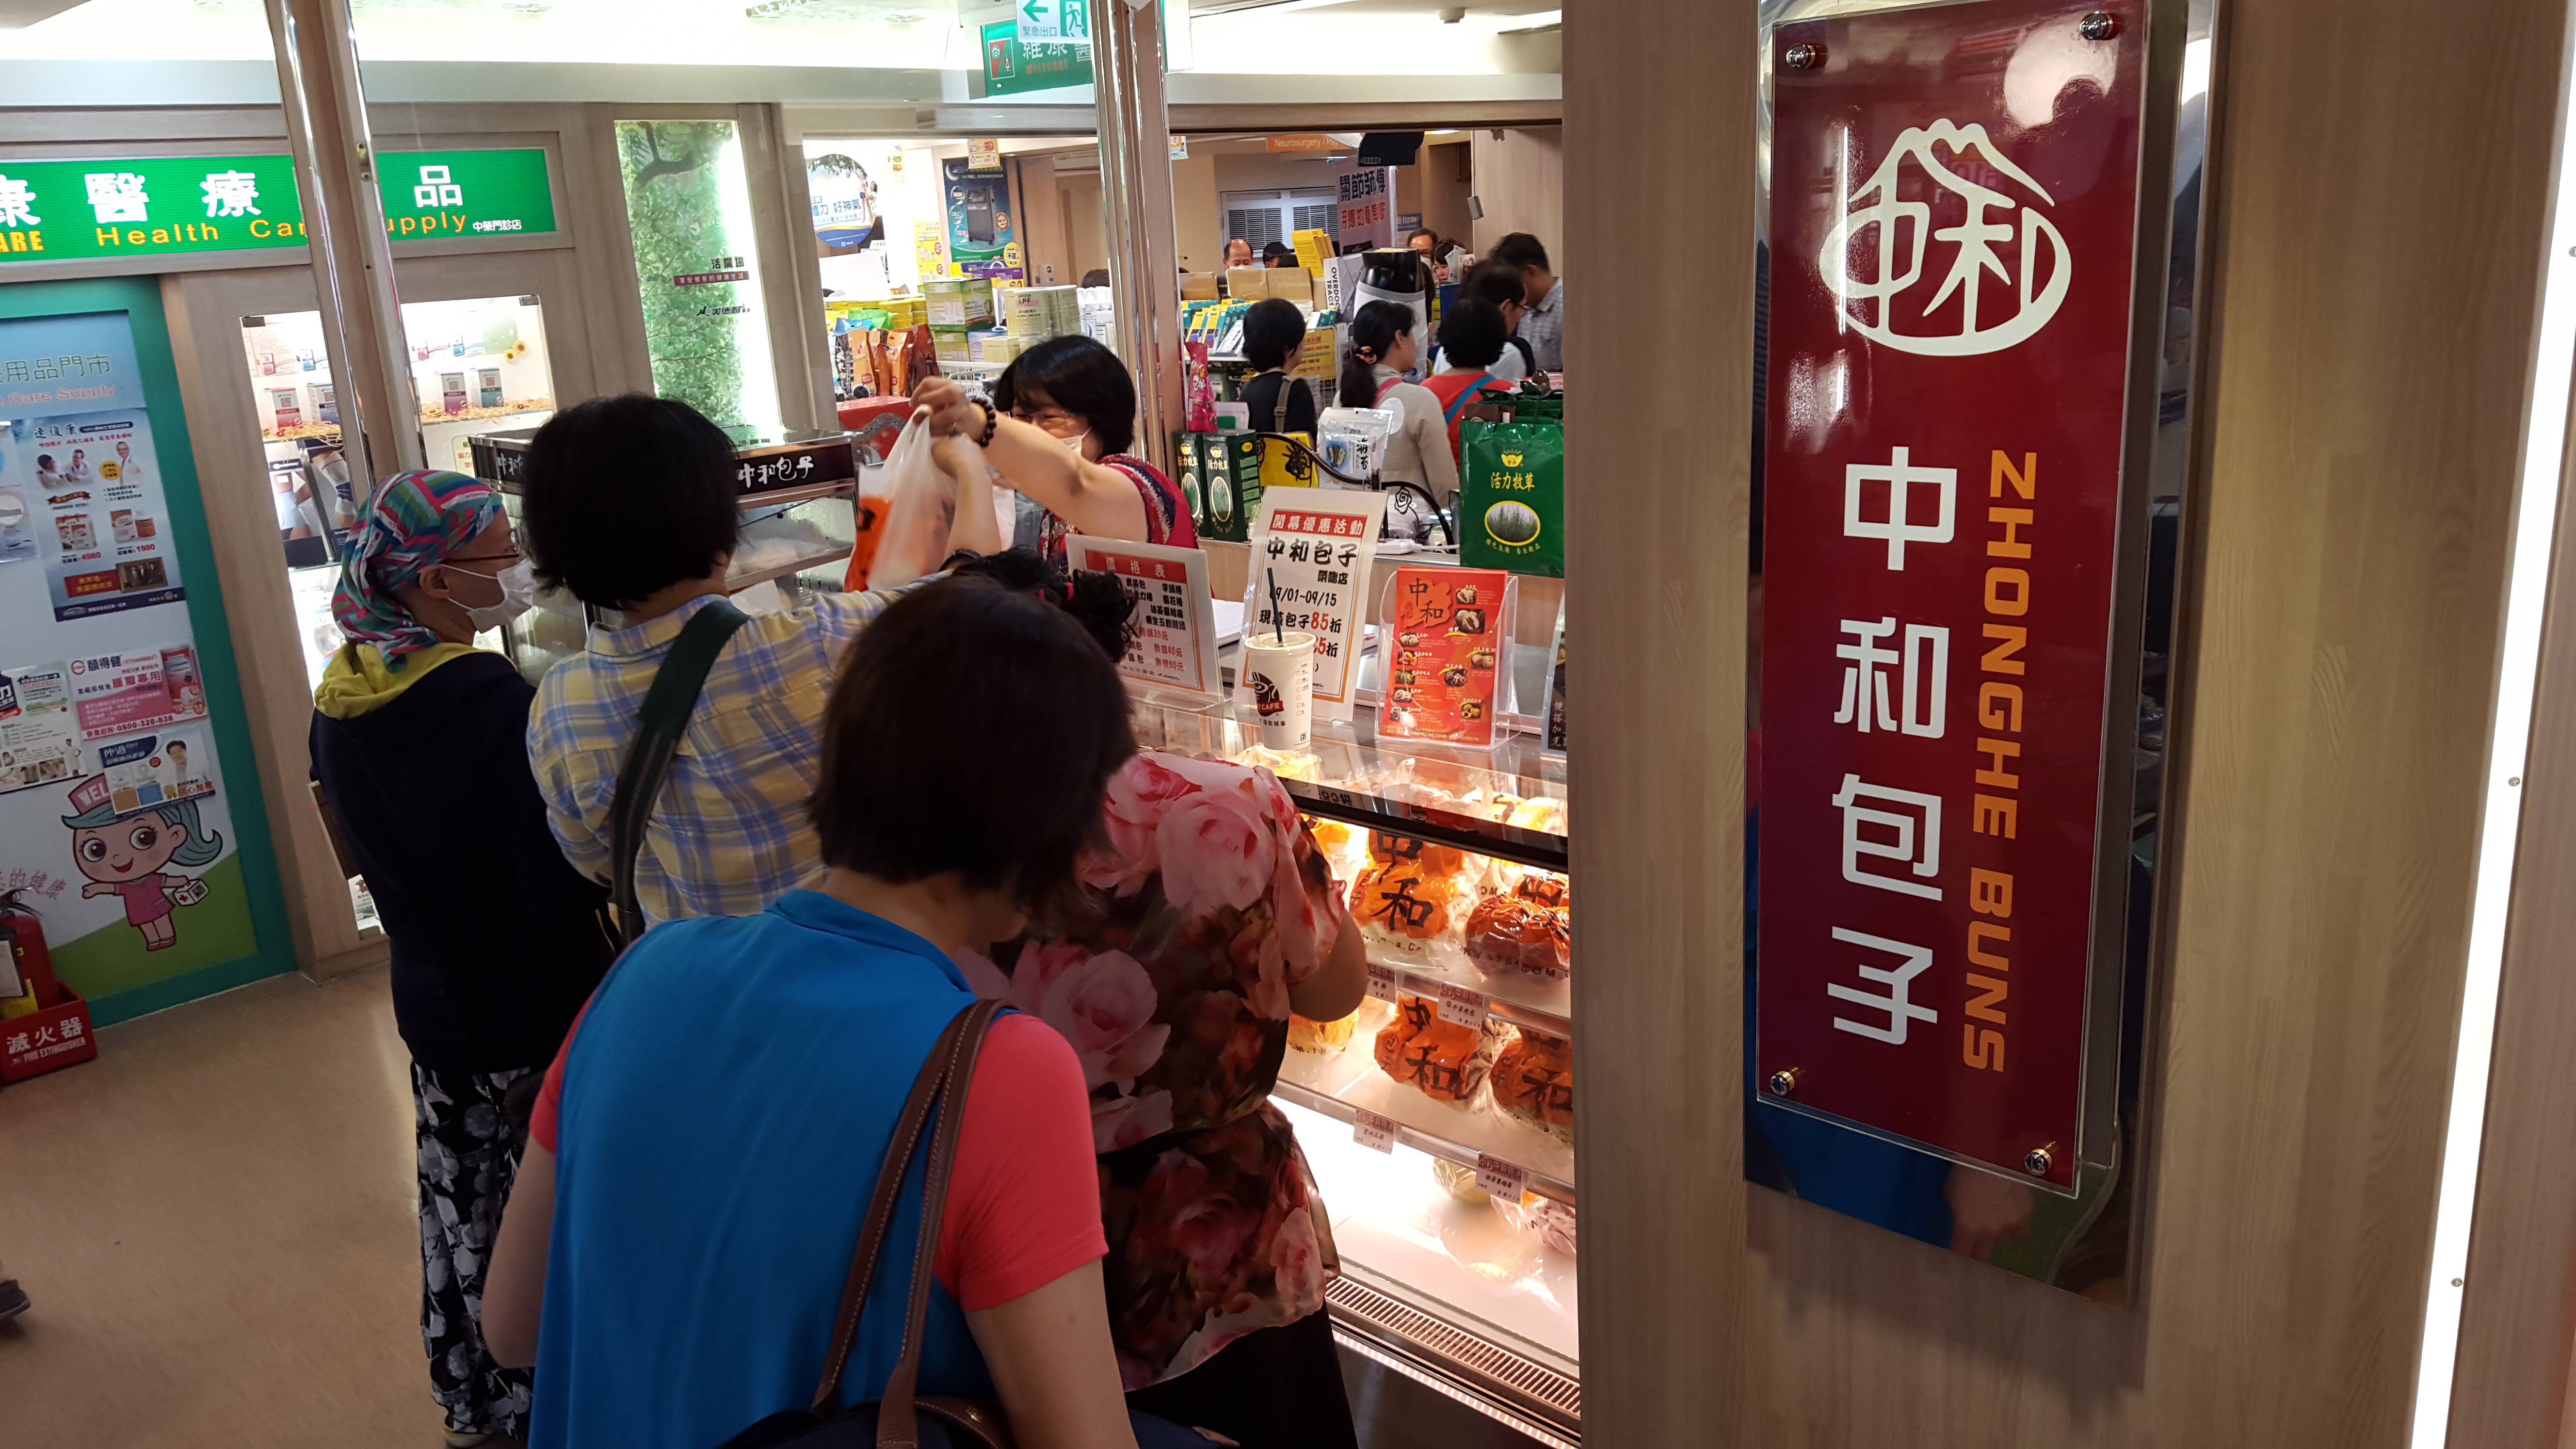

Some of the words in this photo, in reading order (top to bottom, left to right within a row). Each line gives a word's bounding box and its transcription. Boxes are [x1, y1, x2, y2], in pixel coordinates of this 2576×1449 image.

[1022, 26, 1057, 36] 緊急出口
[1274, 138, 1321, 148] Neurosurgery
[833, 199, 861, 213] 好神氣
[96, 222, 220, 246] Health
[250, 219, 305, 239] Car
[387, 211, 467, 235] upply
[472, 219, 523, 232] 中榮門診店
[0, 353, 111, 383] 用品門市
[9, 392, 52, 404] Care
[57, 385, 115, 400] Supply
[737, 455, 814, 488] 中和包子
[1208, 459, 1229, 471] 活力牧草
[1491, 471, 1535, 492] 活力牧草
[1272, 514, 1364, 536] 開幕優惠活動
[136, 544, 156, 552] 1980
[1267, 536, 1358, 567] 中和包子
[1106, 556, 1166, 579] 價格表
[1408, 577, 1444, 625] 中和
[1972, 449, 2038, 840] ZHONGHE
[1155, 657, 1184, 672] 售價60元
[1827, 446, 1958, 1046] 中和包子
[1963, 867, 2014, 1073] BUNS
[6, 1016, 82, 1055] 滅火器
[24, 1050, 40, 1063] FIRE
[40, 1037, 86, 1058] EXTINGUISHER
